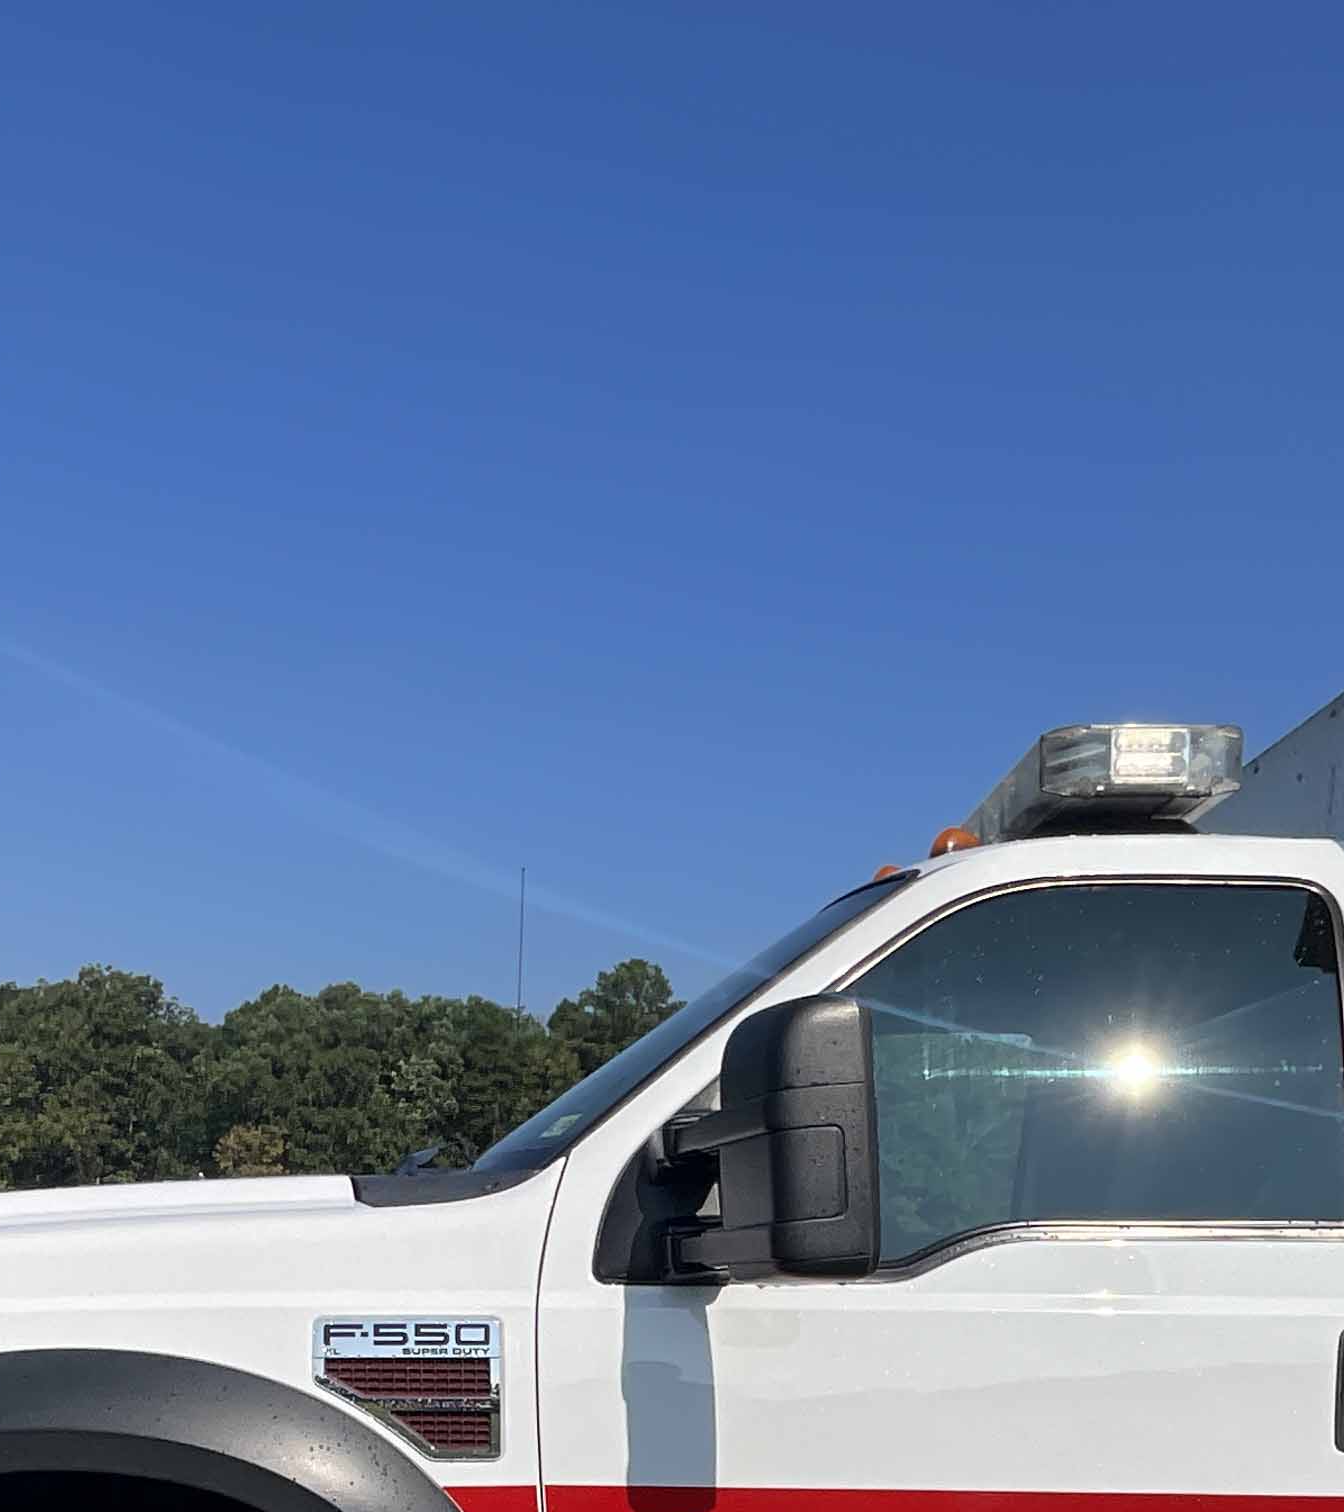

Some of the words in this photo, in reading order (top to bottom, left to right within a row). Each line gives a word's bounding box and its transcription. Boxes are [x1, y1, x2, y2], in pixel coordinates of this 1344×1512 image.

[323, 1323, 491, 1346] F-550
[401, 1348, 448, 1356] SUPER
[452, 1348, 491, 1356] DUTY
